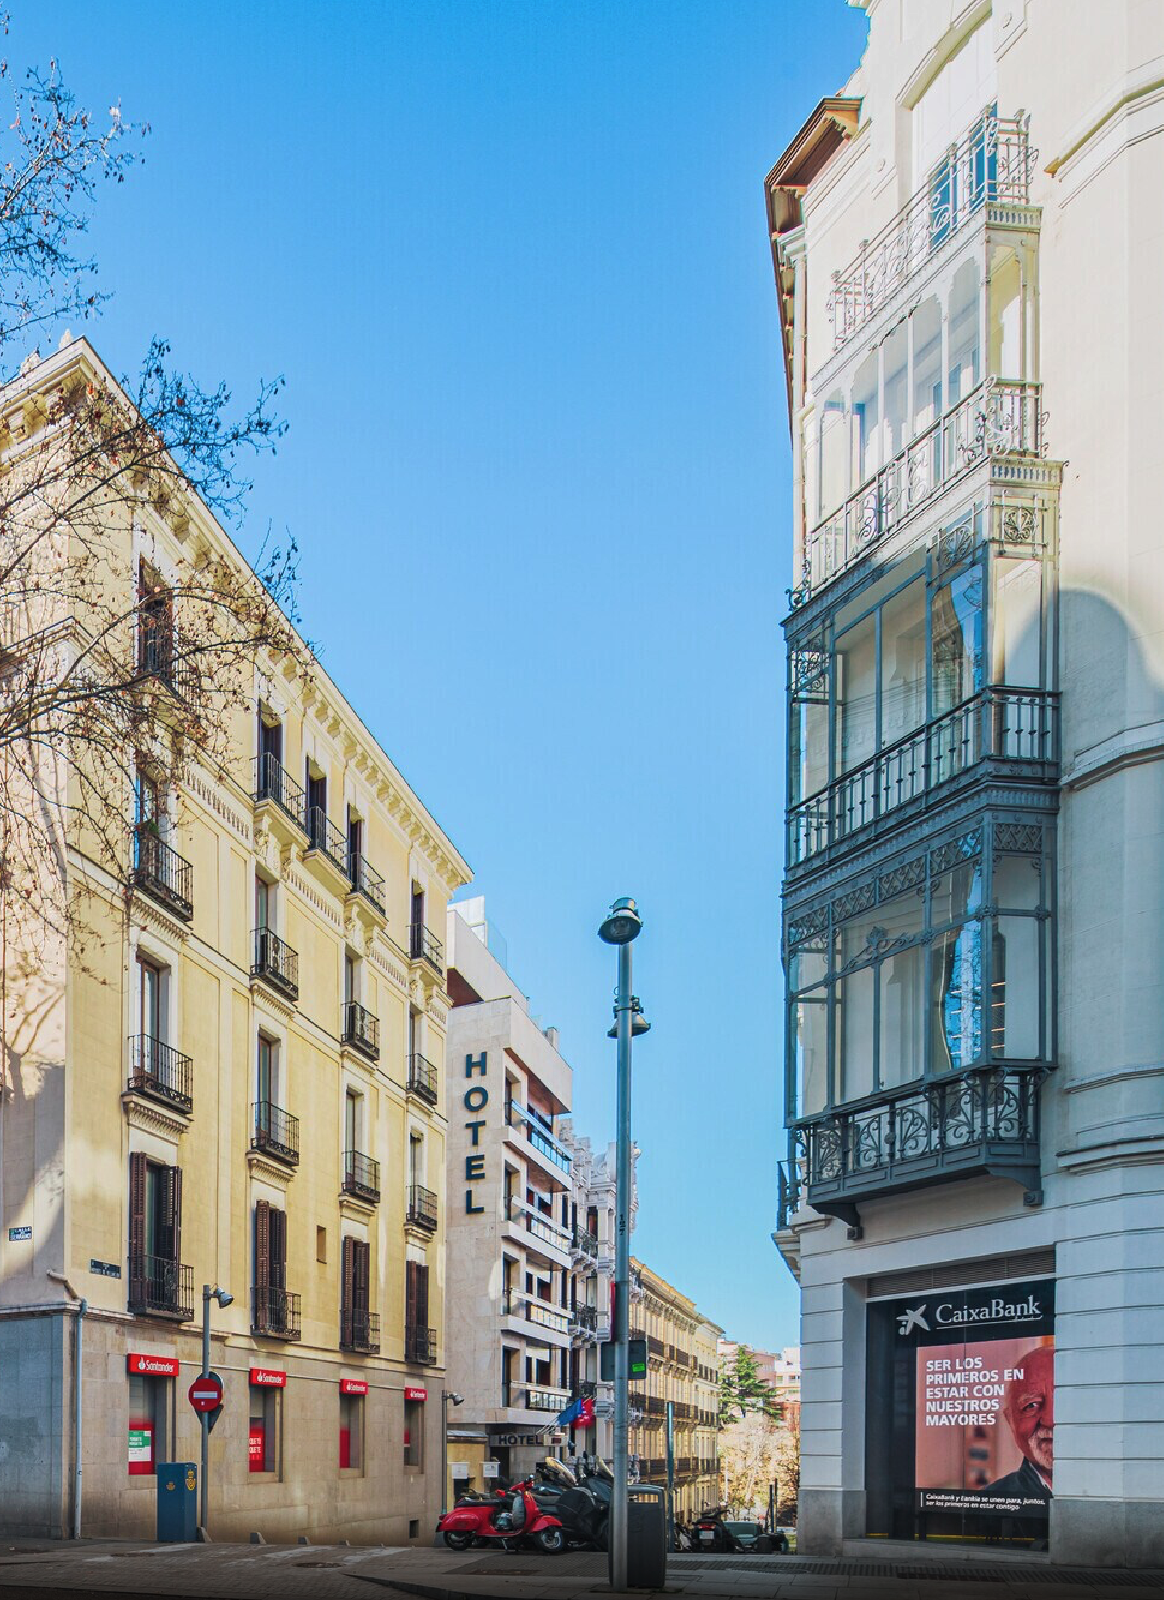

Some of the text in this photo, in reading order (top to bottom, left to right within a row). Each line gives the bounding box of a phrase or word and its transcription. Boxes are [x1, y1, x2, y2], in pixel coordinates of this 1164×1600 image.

[464, 1051, 489, 1215] HOTEL
[936, 1294, 1042, 1323] CaixaBank
[146, 1360, 174, 1372] Santander
[926, 1357, 982, 1371] SER LOS
[926, 1368, 1024, 1385] PRIMEROS EN
[926, 1384, 1005, 1399] ESTAR CON
[926, 1399, 999, 1412] NUESTROS
[926, 1413, 995, 1426] MAYORES
[498, 1434, 544, 1445] HOTEL
